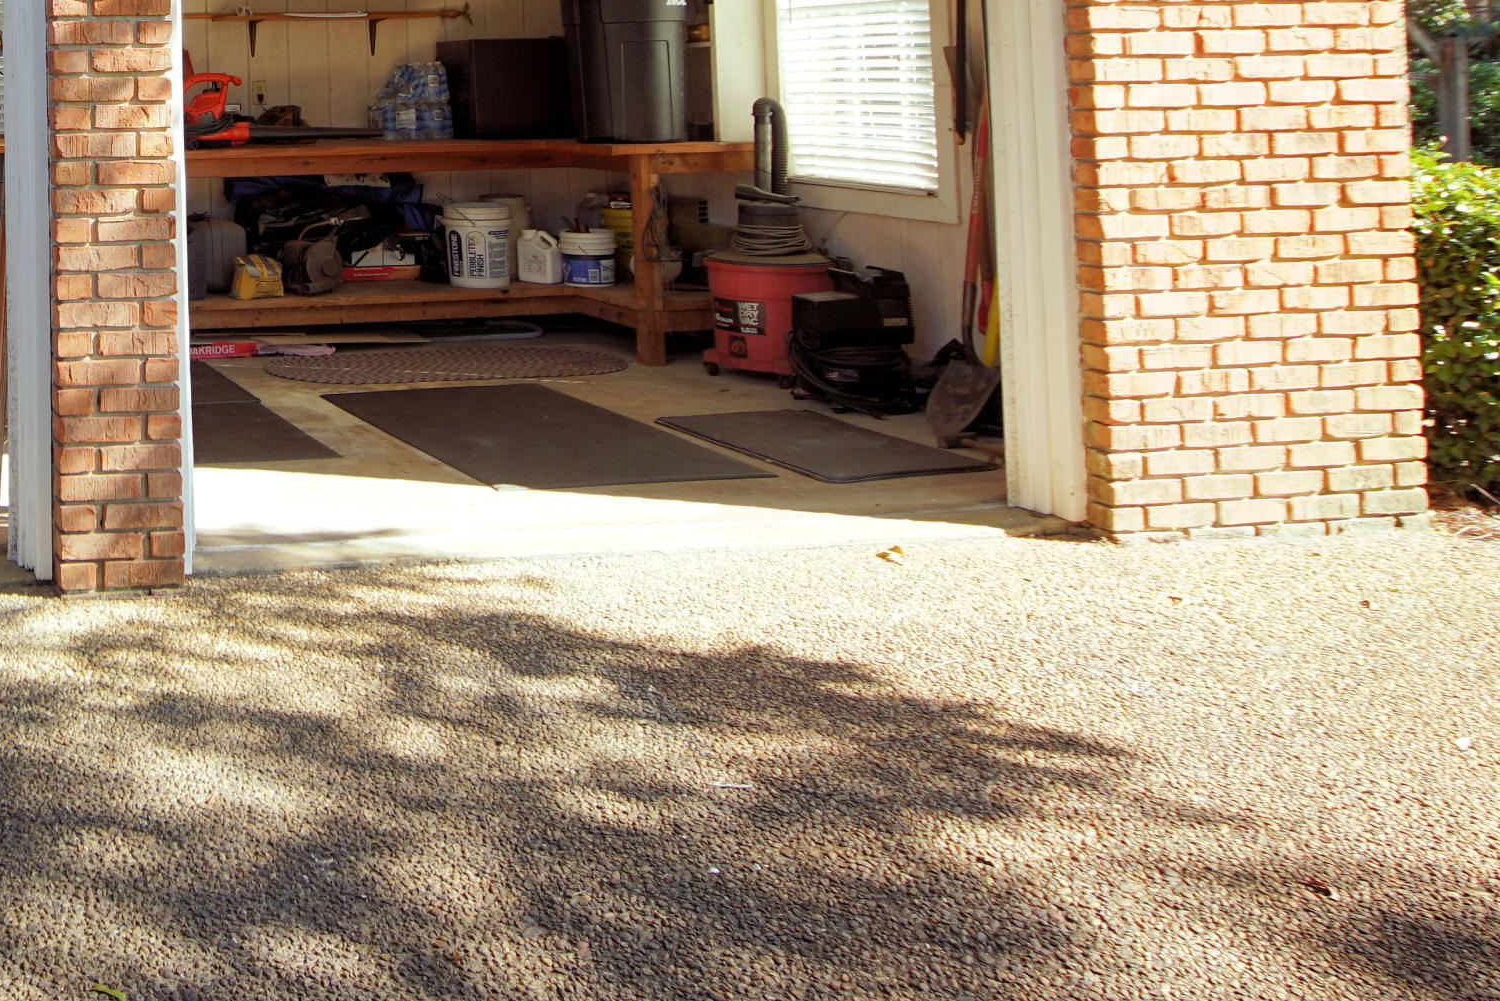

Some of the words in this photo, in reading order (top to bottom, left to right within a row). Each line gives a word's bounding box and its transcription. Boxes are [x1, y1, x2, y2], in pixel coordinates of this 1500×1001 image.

[738, 302, 759, 311] WET
[739, 310, 759, 318] DRY
[740, 317, 759, 326] VAC
